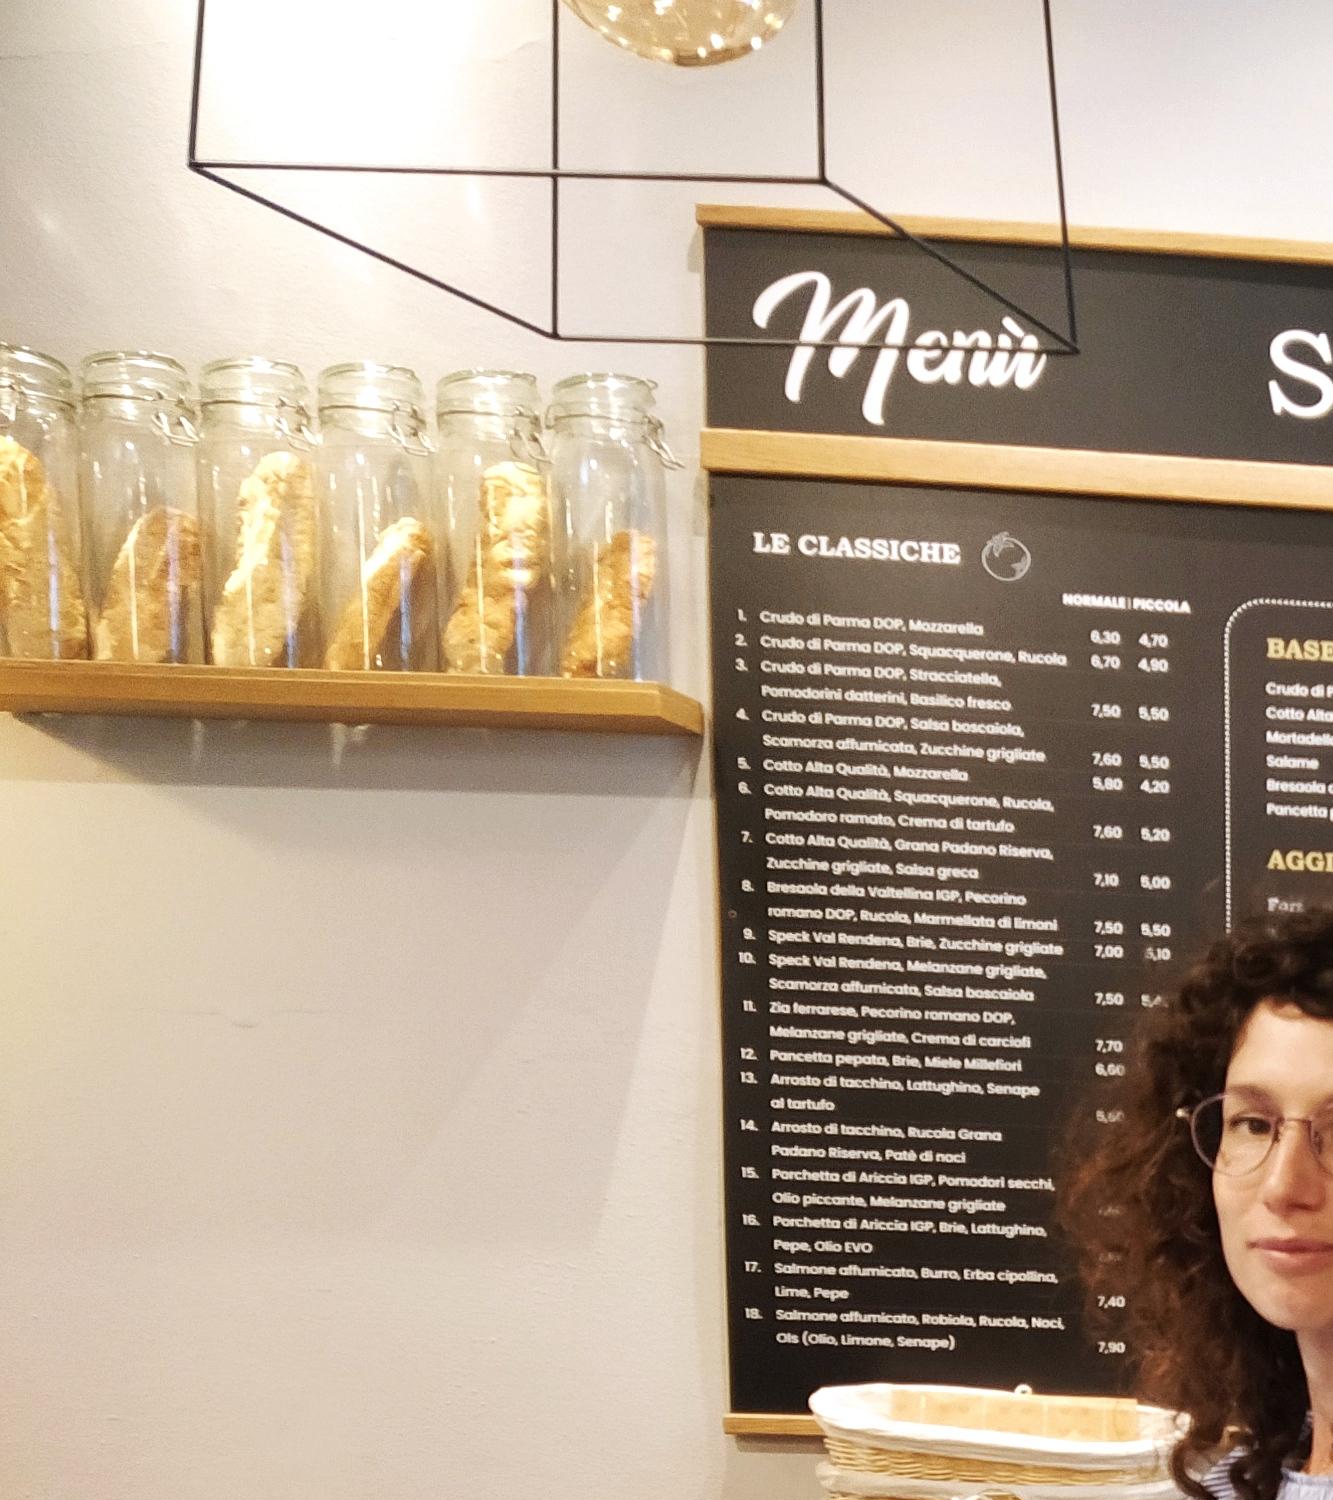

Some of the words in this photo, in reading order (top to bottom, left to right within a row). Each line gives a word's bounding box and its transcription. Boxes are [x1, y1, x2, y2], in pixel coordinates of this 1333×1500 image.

[752, 270, 1047, 424] Menù
[753, 530, 791, 556] LE
[797, 533, 962, 566] CLASSICHE
[1062, 592, 1127, 610] NORMALE
[1132, 596, 1192, 614] PICCOLA
[737, 607, 748, 622] 1.
[759, 609, 805, 625] Crudo
[806, 612, 822, 626] di
[822, 612, 872, 629] Parma
[872, 616, 907, 632] DOP,
[908, 617, 985, 636] Mozzarella
[1138, 632, 1169, 648] 4,70
[734, 632, 748, 647] 2.
[760, 634, 806, 650] Crudo
[806, 636, 822, 650] di
[823, 638, 872, 654] Parma
[873, 640, 907, 656] DOP,
[908, 642, 1017, 664] Squacquerone,
[1017, 649, 1068, 666] Rucola
[735, 656, 749, 672] 3.
[760, 659, 806, 675] Crudo
[806, 661, 822, 675] di
[823, 662, 873, 678] Parma
[873, 665, 908, 681] DOP,
[909, 667, 1002, 687] Stracciatella,
[761, 683, 843, 700] Pomodorini
[843, 688, 908, 706] datterini,
[909, 691, 966, 709] Basilico
[966, 694, 1012, 711] fresco
[1091, 702, 1122, 718] 7,50
[1265, 681, 1310, 697] Crudo
[1310, 683, 1325, 698] di
[1265, 705, 1305, 721] Cotto
[737, 756, 751, 770] 5.
[762, 758, 804, 773] Cotto
[804, 759, 835, 774] Alta
[835, 761, 892, 778] Qualità,
[892, 764, 969, 782] Mozzarella
[1266, 753, 1320, 770] Salame
[1266, 777, 1327, 795] Bresaola
[1266, 802, 1329, 818] Pancetta
[744, 1259, 762, 1273] 17.
[774, 1261, 837, 1275] Salmone
[838, 1263, 919, 1280] affumicato,
[920, 1266, 962, 1281] Burro,
[963, 1267, 996, 1281] Erba
[996, 1268, 1059, 1285] cipollina,
[774, 1284, 812, 1299] Lime,
[813, 1286, 850, 1301] Pepe
[1097, 1294, 1126, 1308] 7,40
[744, 1306, 763, 1320] 18.
[775, 1308, 839, 1322] Salmone
[839, 1309, 920, 1325] affumicato,
[921, 1312, 977, 1327] Robiola,
[978, 1314, 1030, 1329] Rucola,
[1030, 1316, 1065, 1330] Noci,
[801, 1329, 839, 1346] (Olio,
[840, 1333, 895, 1348] Limone,
[896, 1333, 956, 1351] Senape)
[1098, 1340, 1126, 1354] 7,90
